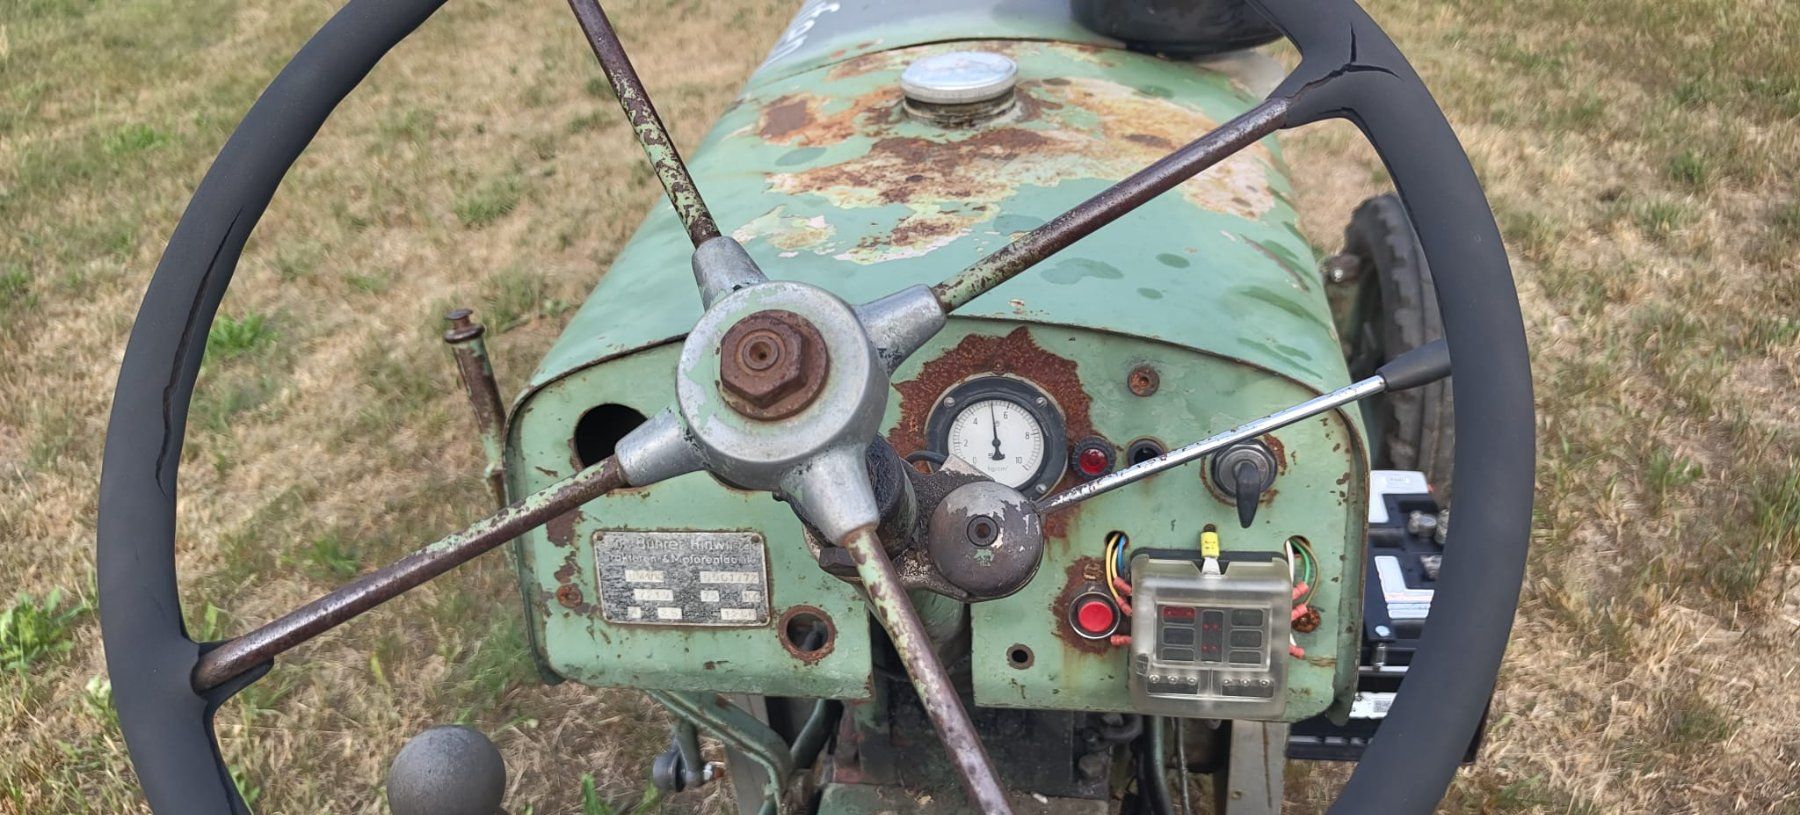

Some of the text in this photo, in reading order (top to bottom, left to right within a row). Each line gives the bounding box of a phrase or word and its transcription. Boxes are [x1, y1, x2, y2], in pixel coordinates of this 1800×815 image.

[973, 417, 978, 425] 4
[1025, 432, 1030, 440] 8
[963, 439, 968, 447] 2
